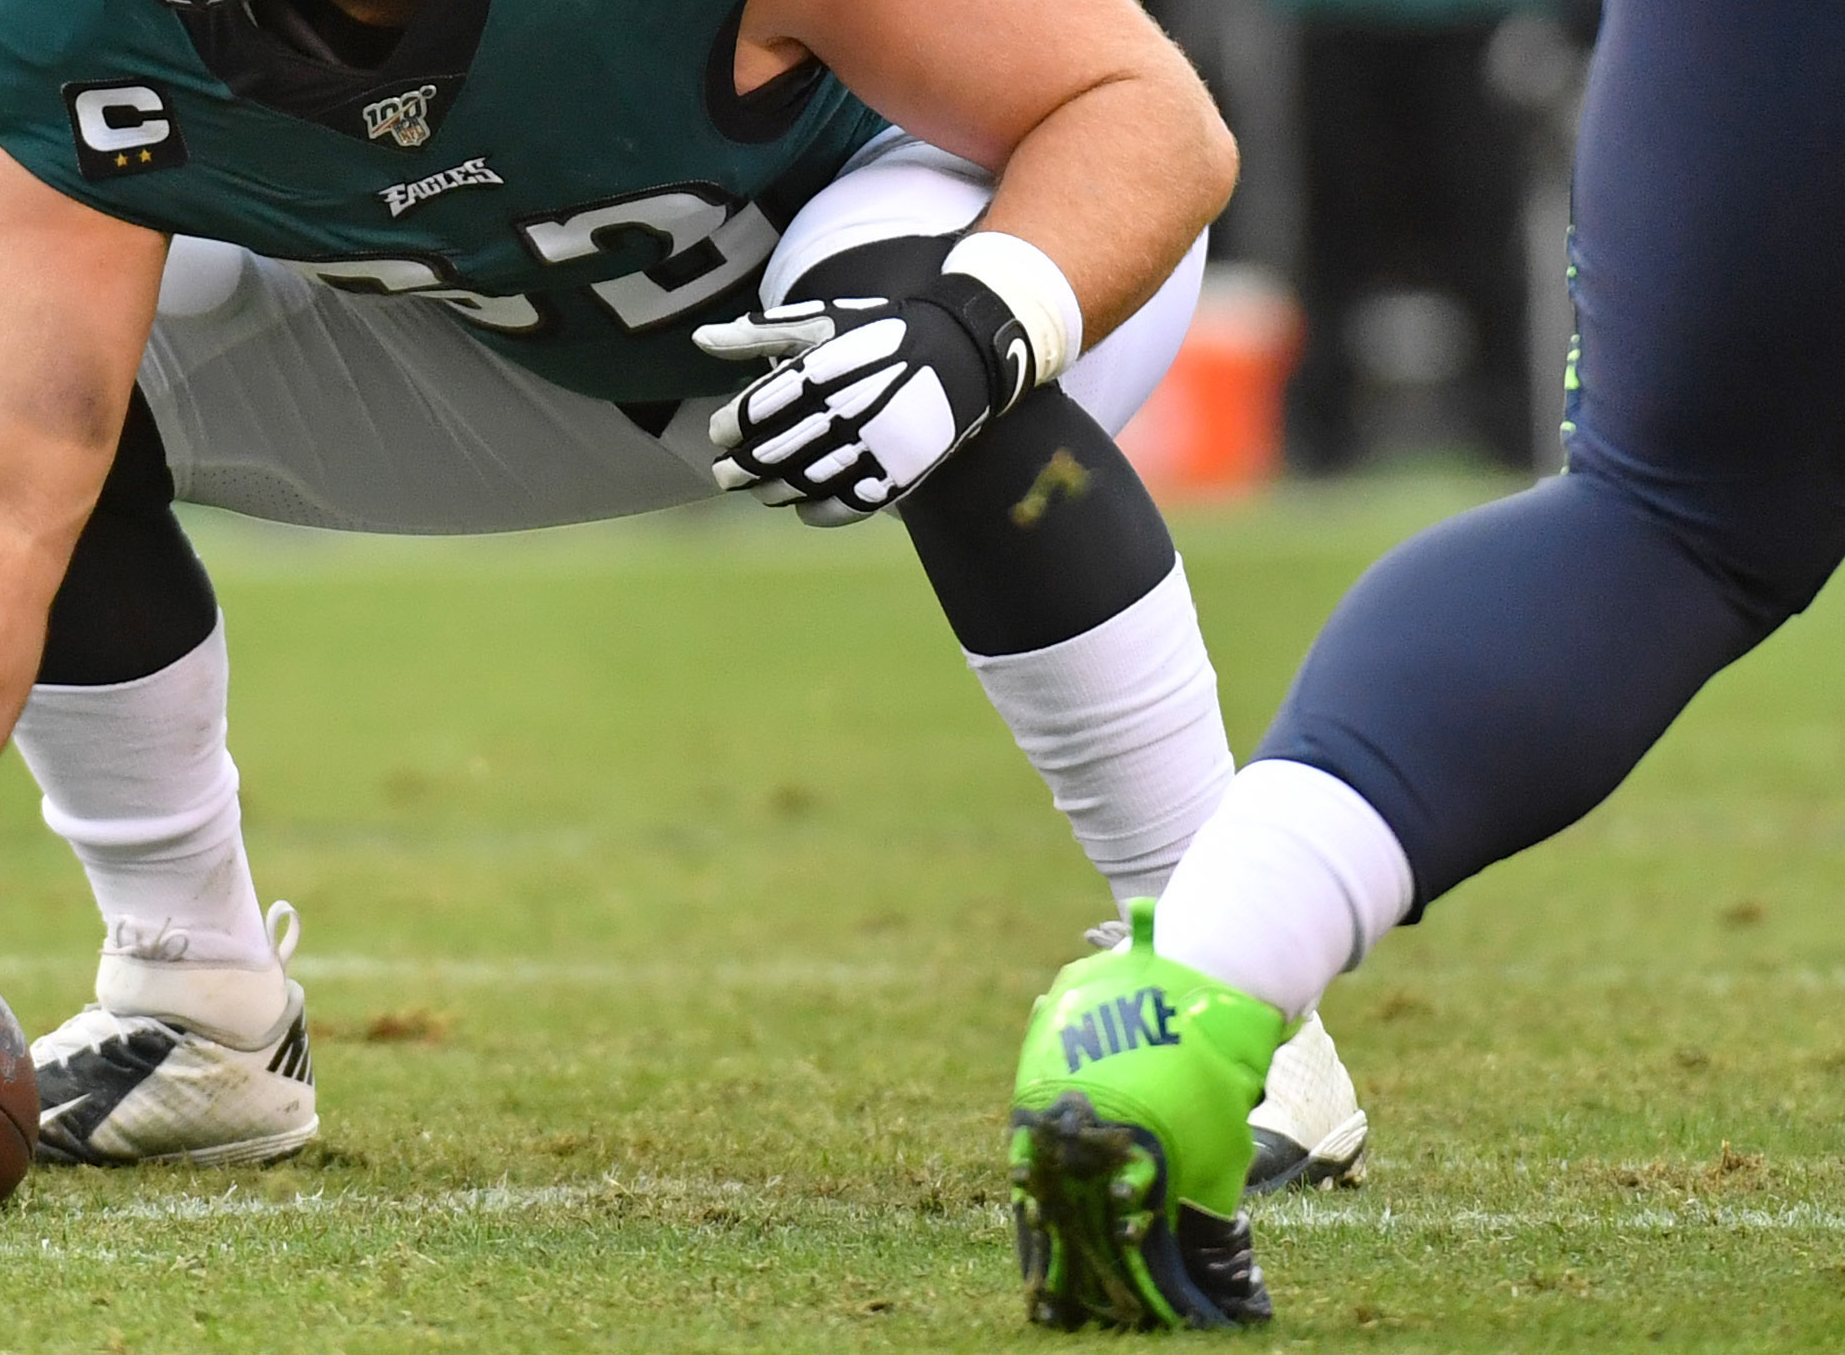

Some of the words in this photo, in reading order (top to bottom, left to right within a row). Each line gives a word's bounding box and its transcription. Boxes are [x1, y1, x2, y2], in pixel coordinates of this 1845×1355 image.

[75, 86, 170, 152] C
[378, 157, 504, 218] EAGLES
[1059, 986, 1182, 1074] NIKE
